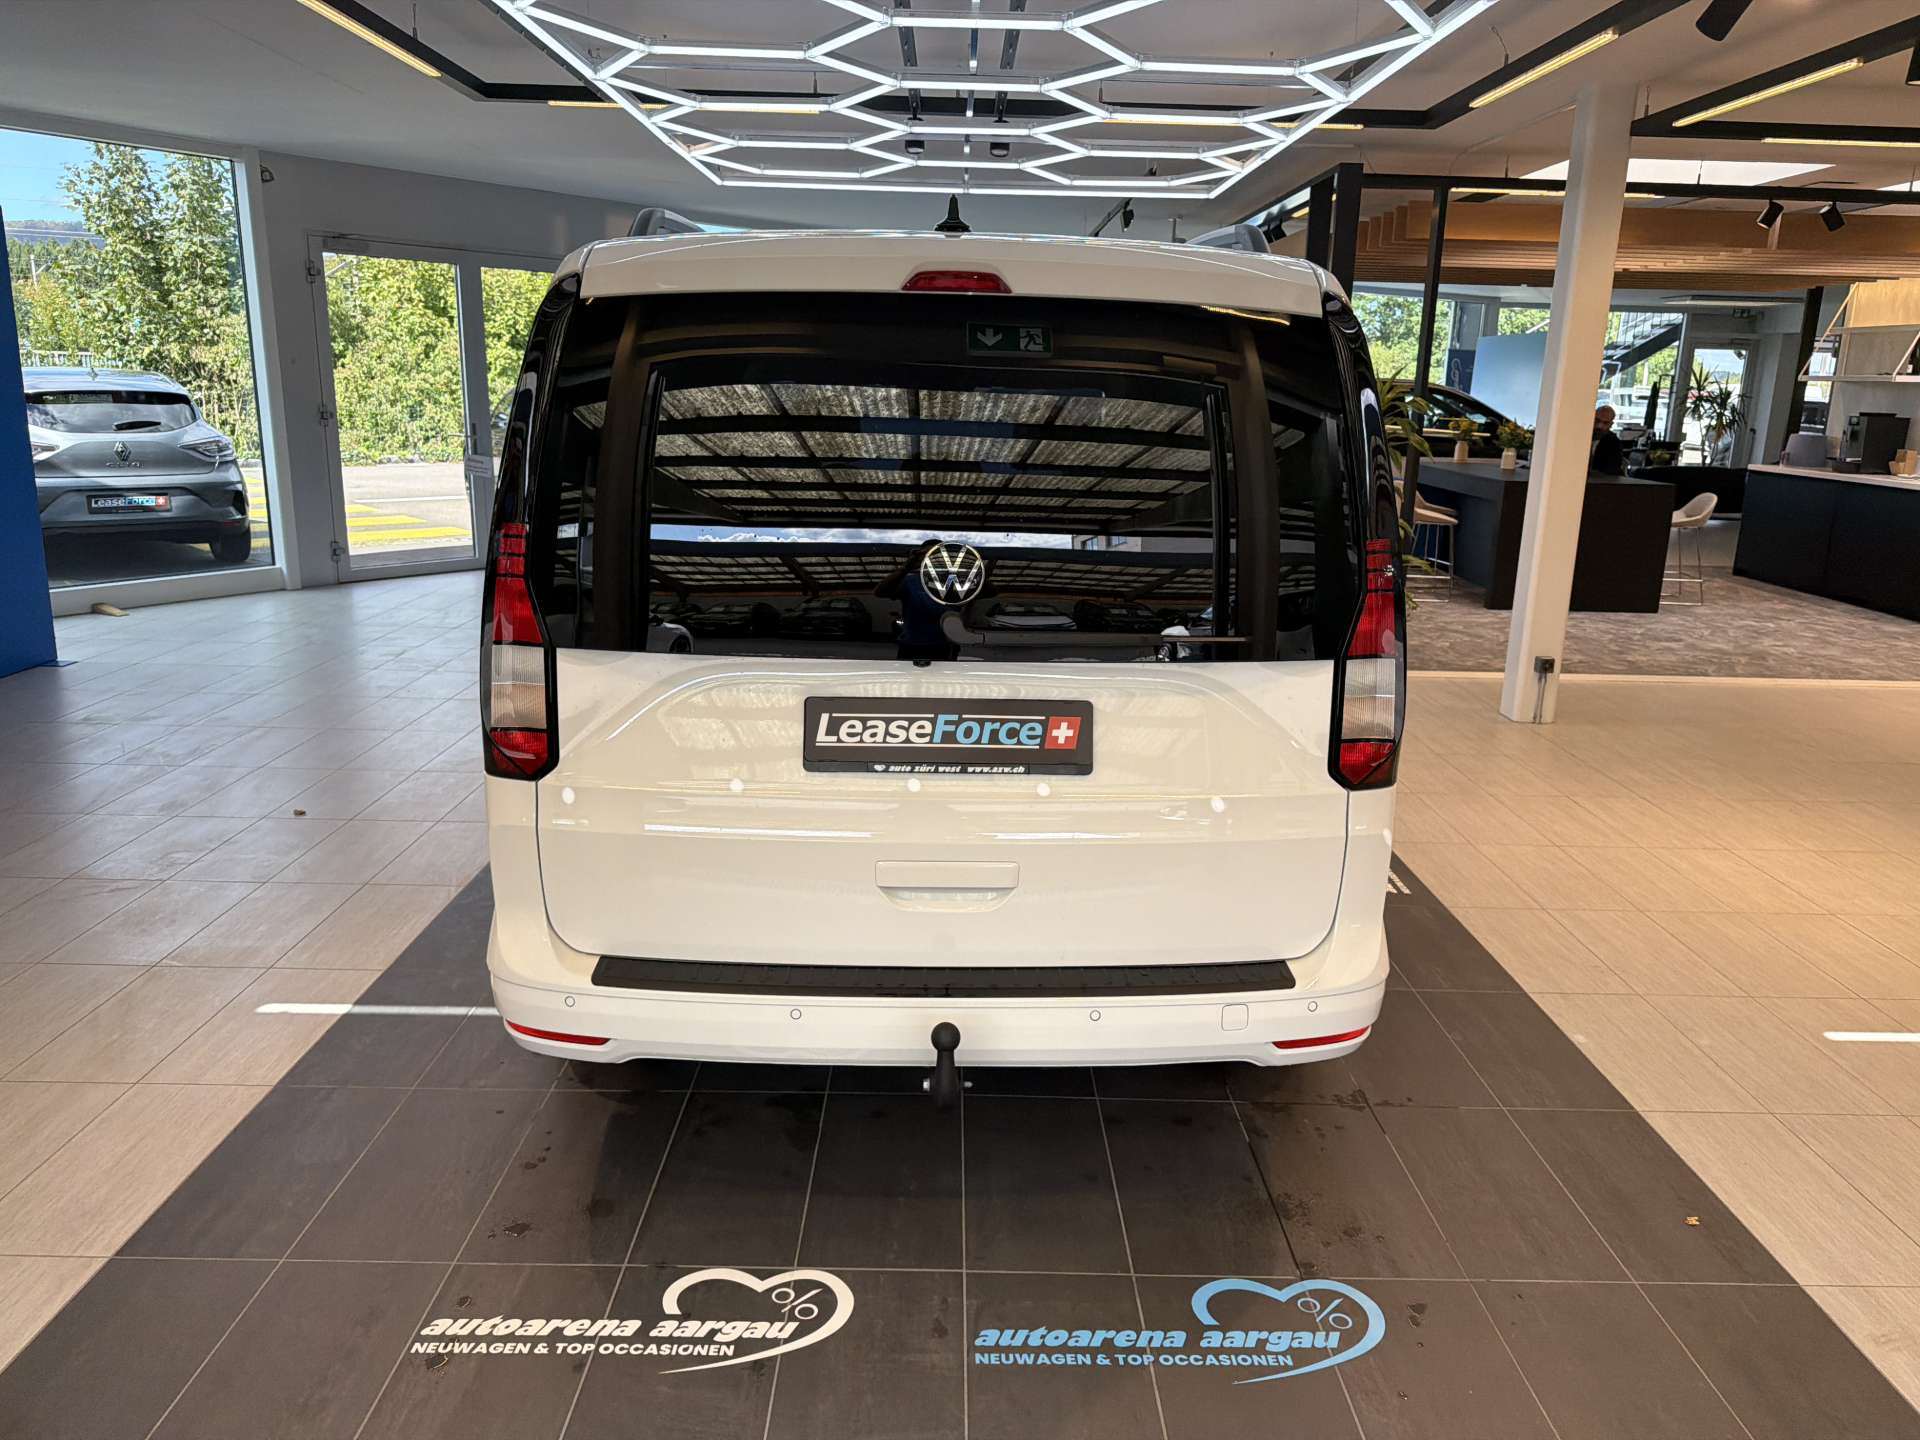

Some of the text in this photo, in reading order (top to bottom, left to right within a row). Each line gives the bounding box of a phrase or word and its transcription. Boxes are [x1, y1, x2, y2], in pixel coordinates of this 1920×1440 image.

[816, 712, 1043, 745] LeaseForce
[888, 764, 911, 772] auto
[938, 765, 961, 773] west
[420, 1315, 800, 1342] autoarena aargau
[410, 1342, 735, 1356] NEUWAGEN & TOP OCCASIONEN
[974, 1326, 1340, 1352] autoarena aargau
[975, 1353, 1294, 1366] NEUWAGEN & TOP OCCASIONEN
